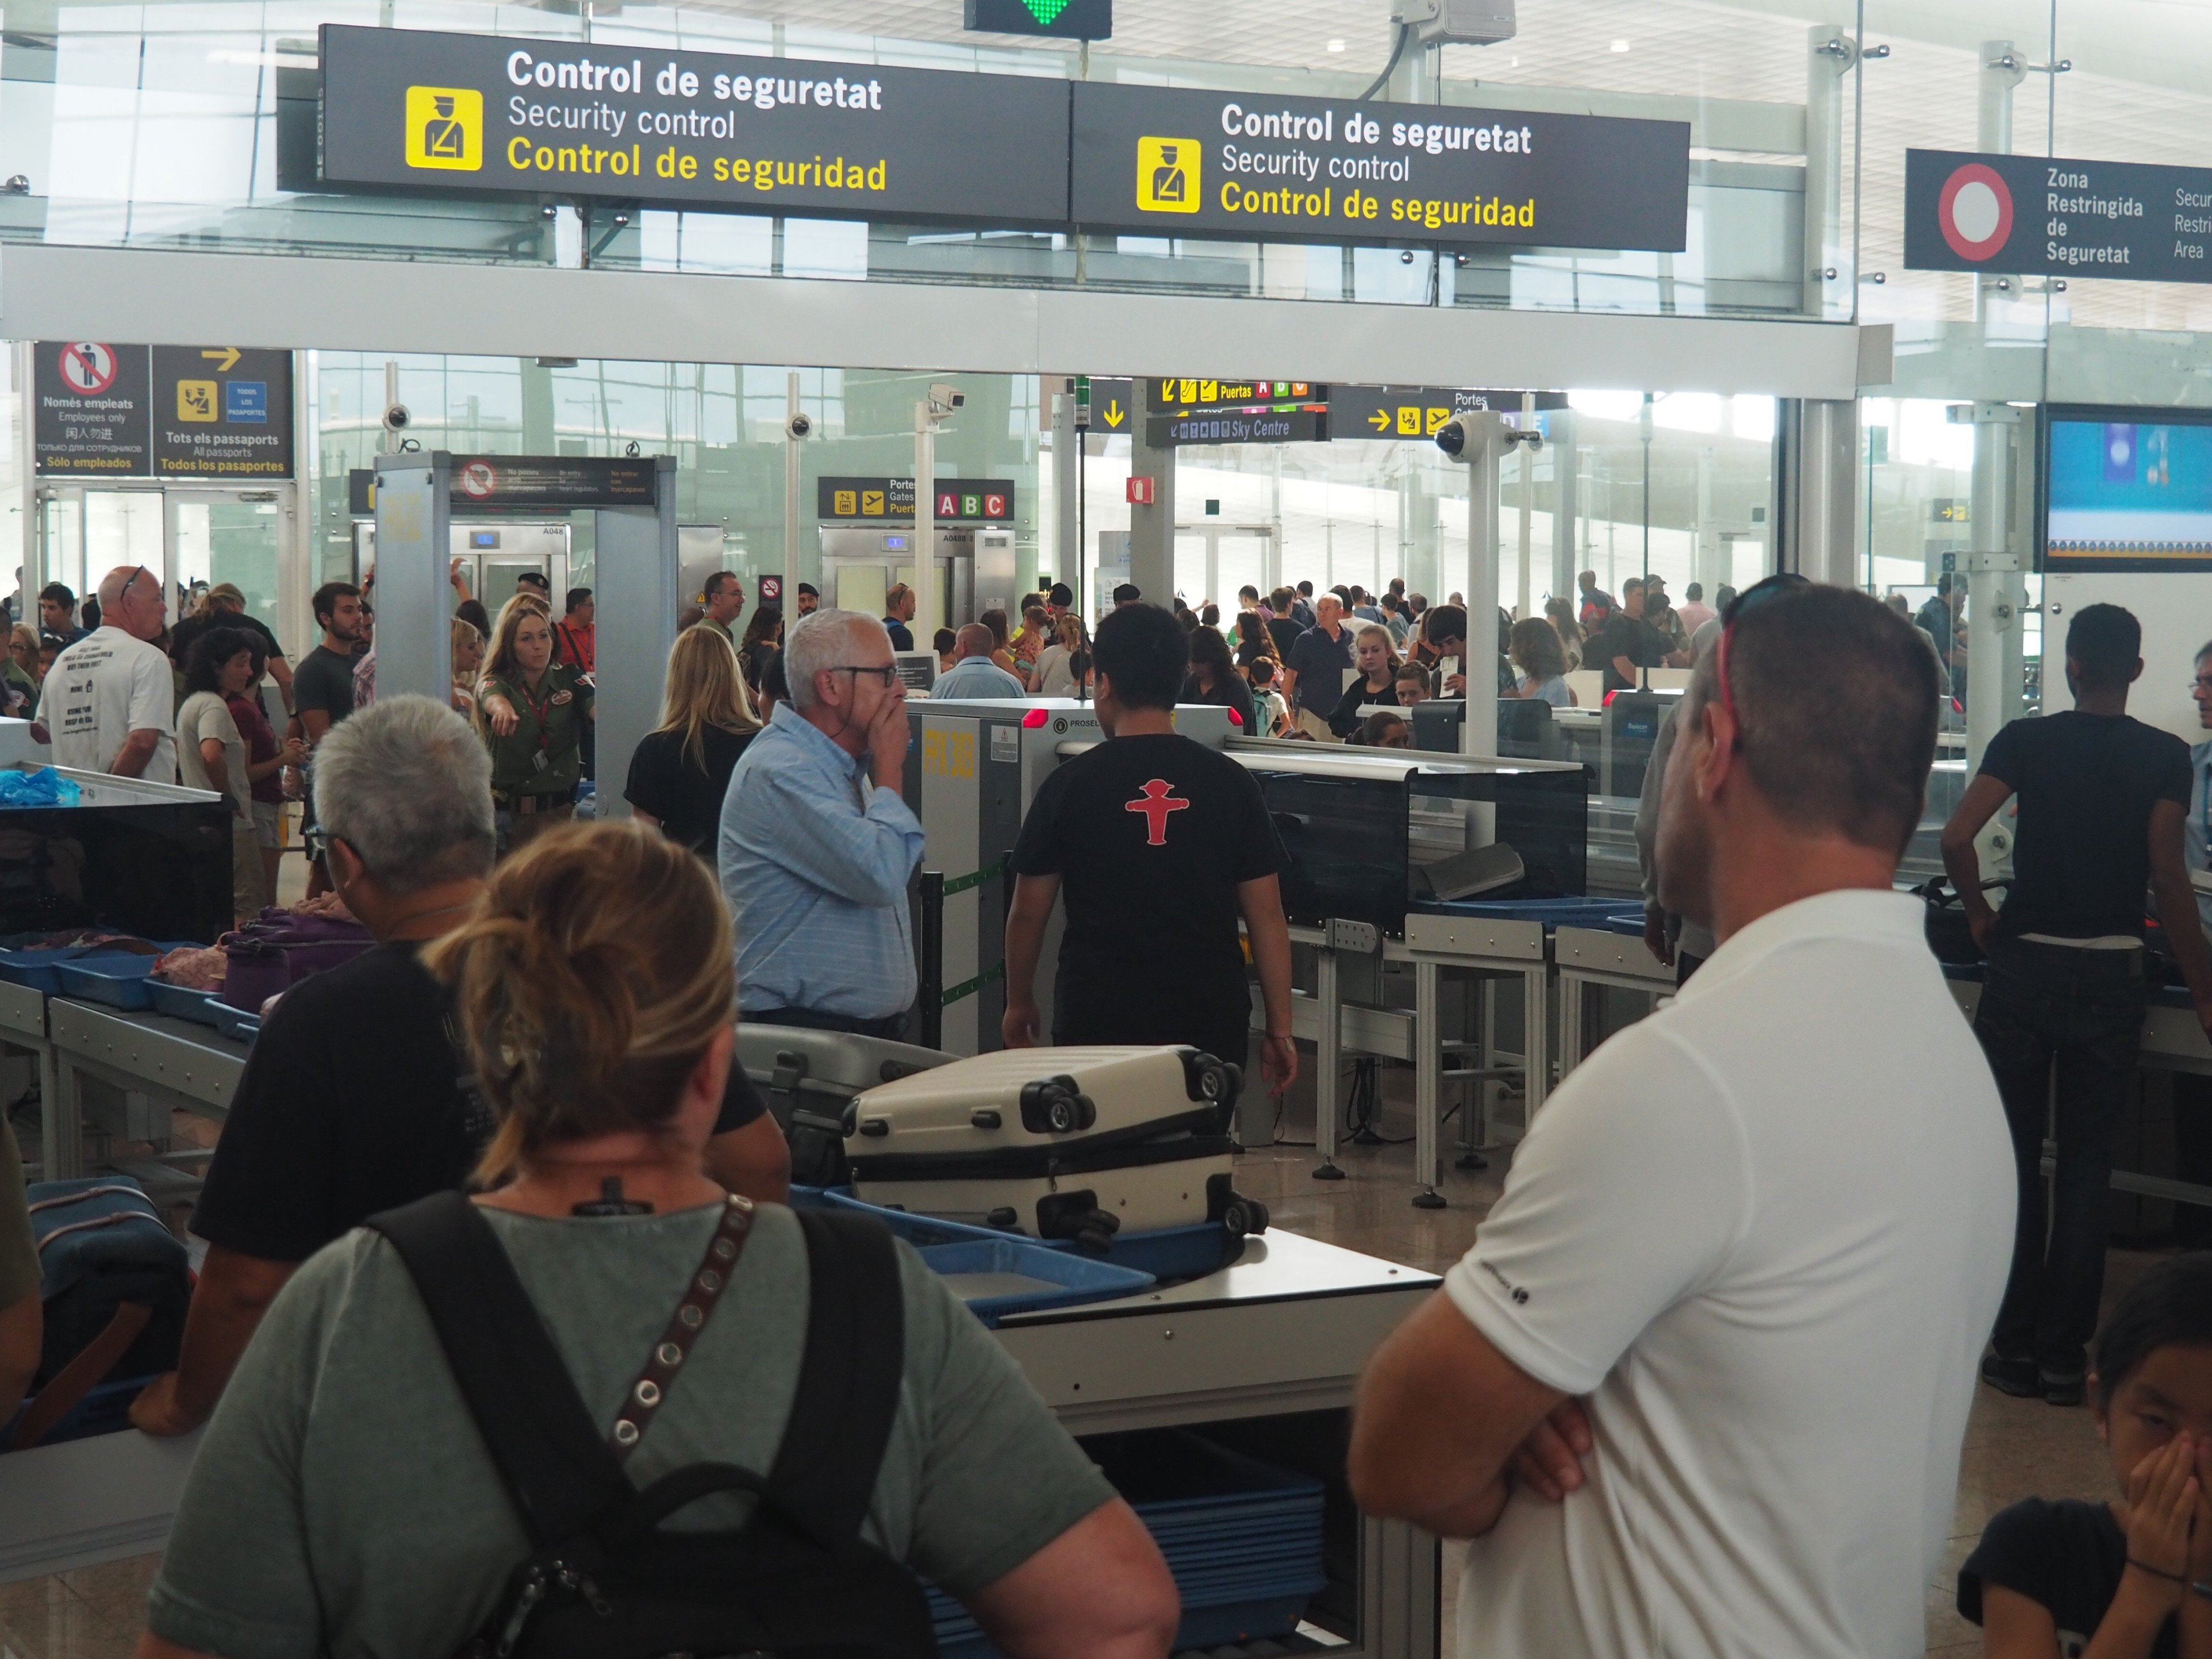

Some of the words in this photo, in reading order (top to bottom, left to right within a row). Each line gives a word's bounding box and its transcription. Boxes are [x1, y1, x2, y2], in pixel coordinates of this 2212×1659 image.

[507, 51, 640, 93] Control
[656, 63, 698, 97] de
[714, 76, 881, 110] seguretat
[509, 96, 626, 138] Security
[638, 111, 735, 139] control
[1222, 103, 1332, 141] Control
[1345, 113, 1379, 144] de
[1392, 122, 1531, 154] seguretat
[508, 137, 640, 176] Control
[656, 147, 697, 180] de
[714, 156, 885, 190] seguridad
[1222, 145, 1319, 181] Security
[1328, 155, 1409, 181] control
[2047, 168, 2088, 189] Zona
[1220, 182, 1330, 216] Control
[1344, 189, 1378, 219] de
[1391, 196, 1534, 228] seguridad
[2047, 193, 2143, 219] Restringida
[2047, 217, 2067, 236] de
[2175, 214, 2212, 233] Restri
[2047, 242, 2130, 265] Seguretat
[2174, 240, 2203, 259] Area
[1220, 385, 1251, 399] Puertas
[1259, 382, 1267, 393] A
[1455, 393, 1486, 406] Portes
[44, 397, 82, 408] Només
[85, 398, 133, 410] empleats
[59, 412, 106, 424] Employees
[109, 414, 126, 424] only
[1533, 415, 1543, 432] E
[66, 427, 113, 440] 闲人勿进
[166, 432, 191, 444] Tots
[195, 433, 211, 444] els
[213, 435, 279, 446] passaports
[1232, 420, 1250, 440] Sky
[1254, 420, 1290, 437] Centre
[194, 446, 206, 456] All
[206, 448, 252, 458] passports
[47, 456, 70, 467] Sólo
[74, 457, 132, 469] empleados
[161, 458, 196, 470] Todos
[199, 459, 216, 471] los
[218, 461, 284, 473] pasaportes
[890, 479, 916, 489] Portes
[890, 492, 914, 502] Gates
[941, 497, 954, 514] A
[965, 497, 977, 514] B
[988, 497, 1001, 514] C
